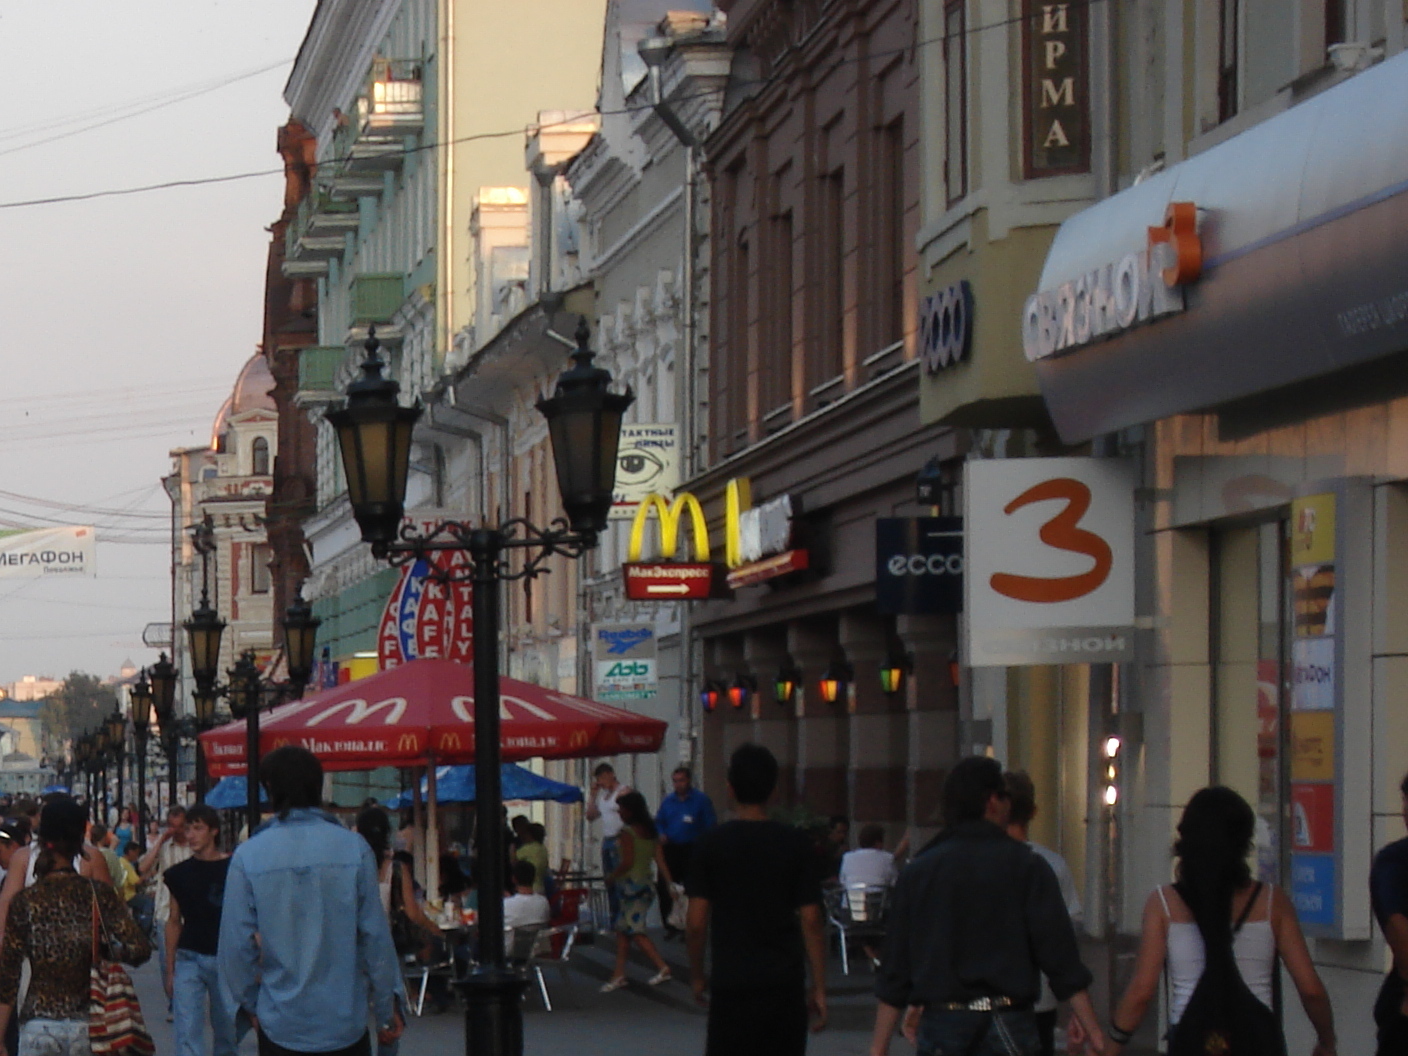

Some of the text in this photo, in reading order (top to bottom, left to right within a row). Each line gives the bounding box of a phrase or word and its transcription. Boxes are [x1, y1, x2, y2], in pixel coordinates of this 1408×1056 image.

[1041, 3, 1076, 147] ИРМА
[628, 566, 709, 581] МакЭкспресс
[888, 554, 963, 577] ecco
